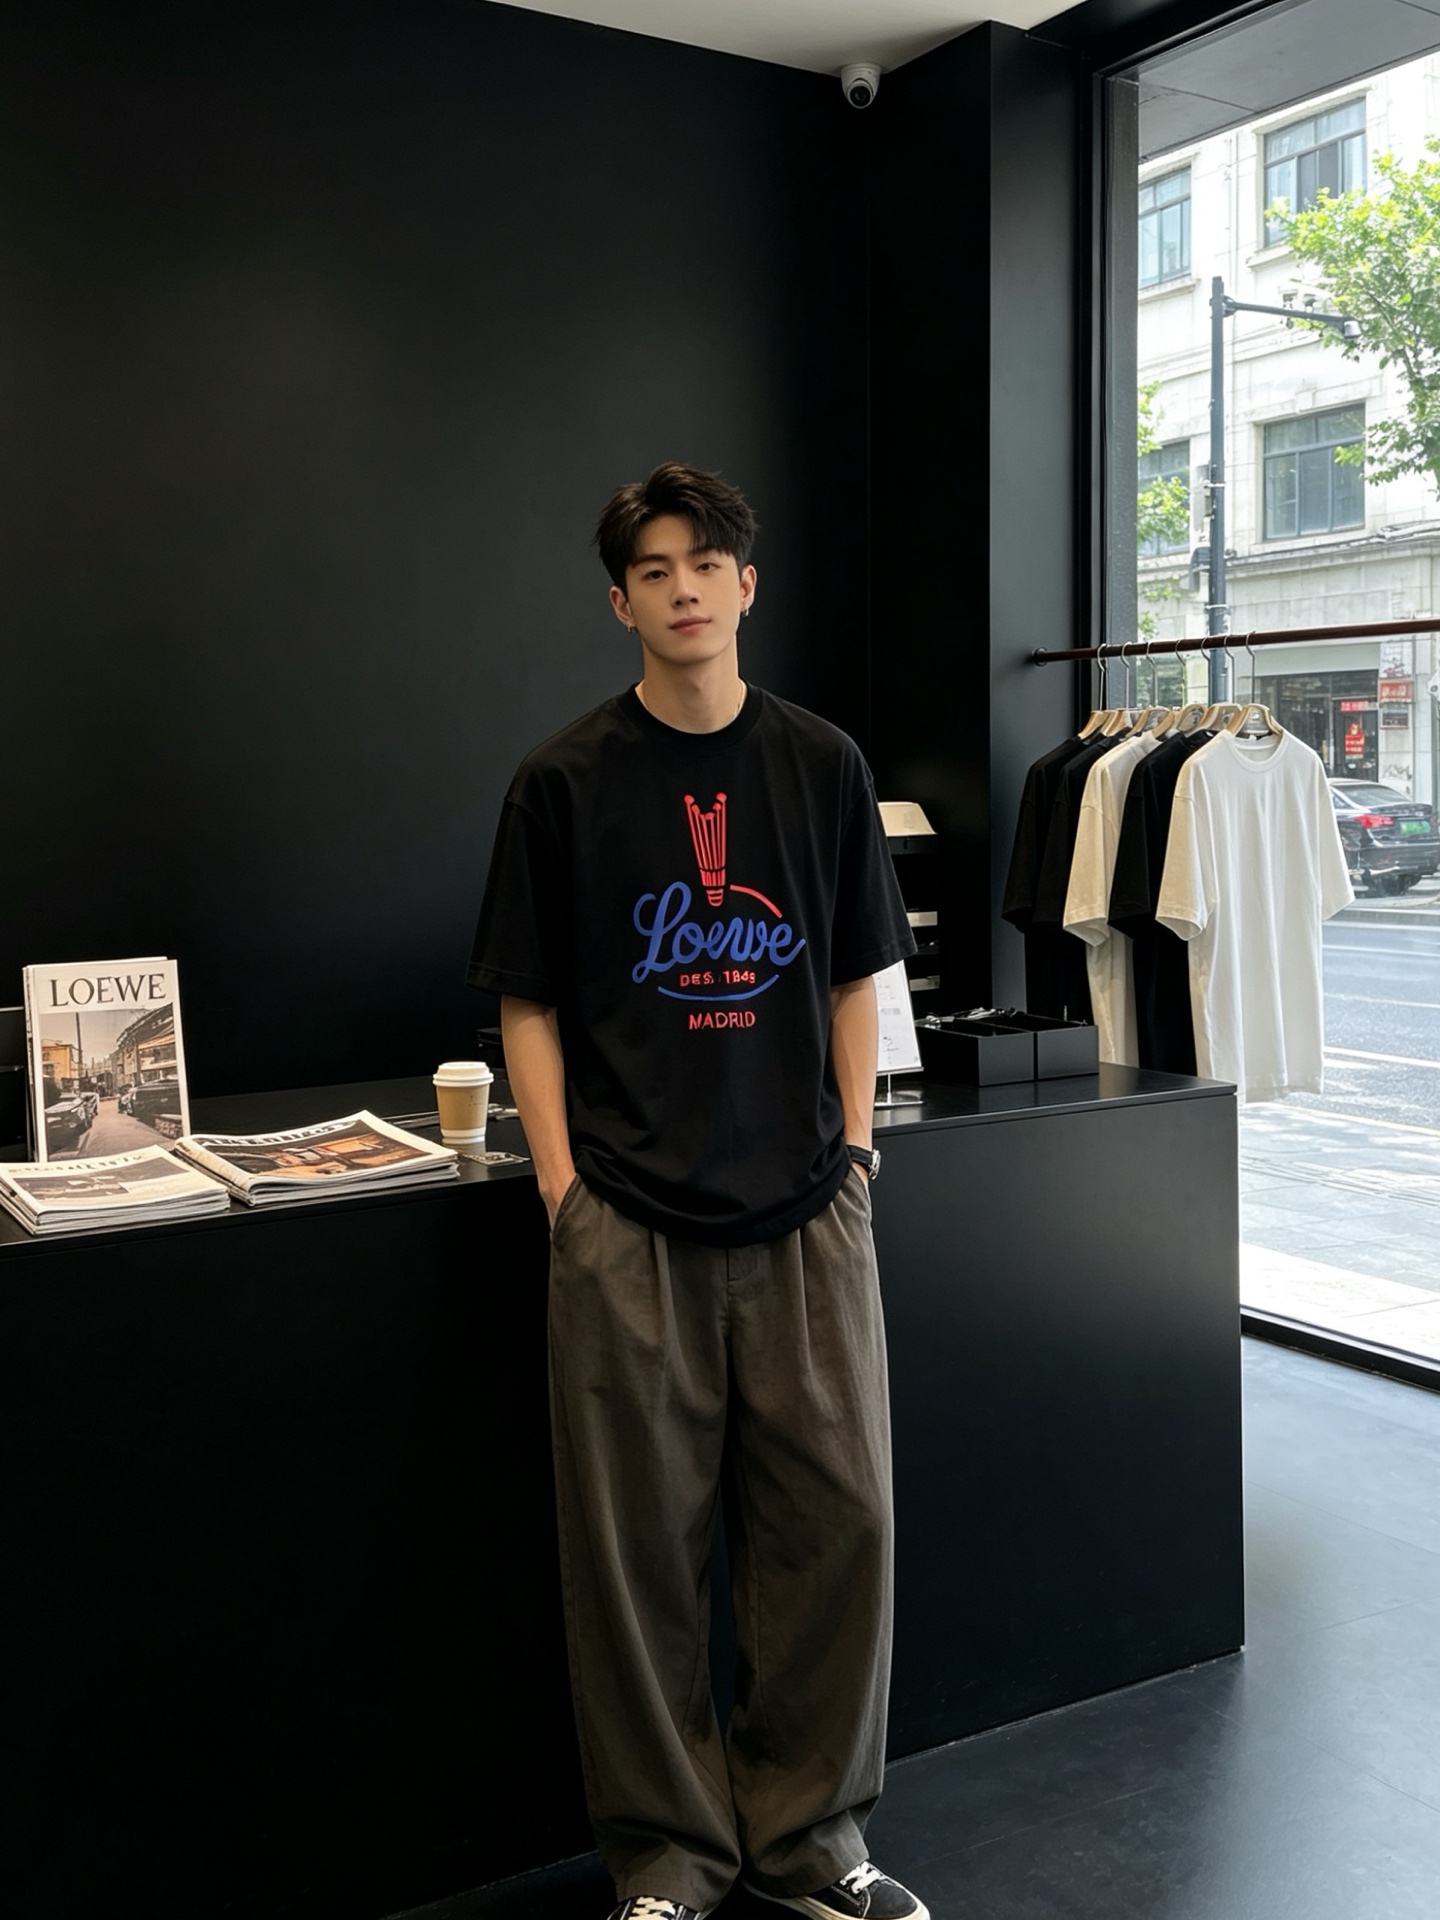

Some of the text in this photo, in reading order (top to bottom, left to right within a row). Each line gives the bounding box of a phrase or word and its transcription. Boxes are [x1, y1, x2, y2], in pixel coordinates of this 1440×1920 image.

[632, 881, 806, 983] Loewe
[50, 973, 167, 1007] LOEWE
[689, 1011, 756, 1030] MADRID
